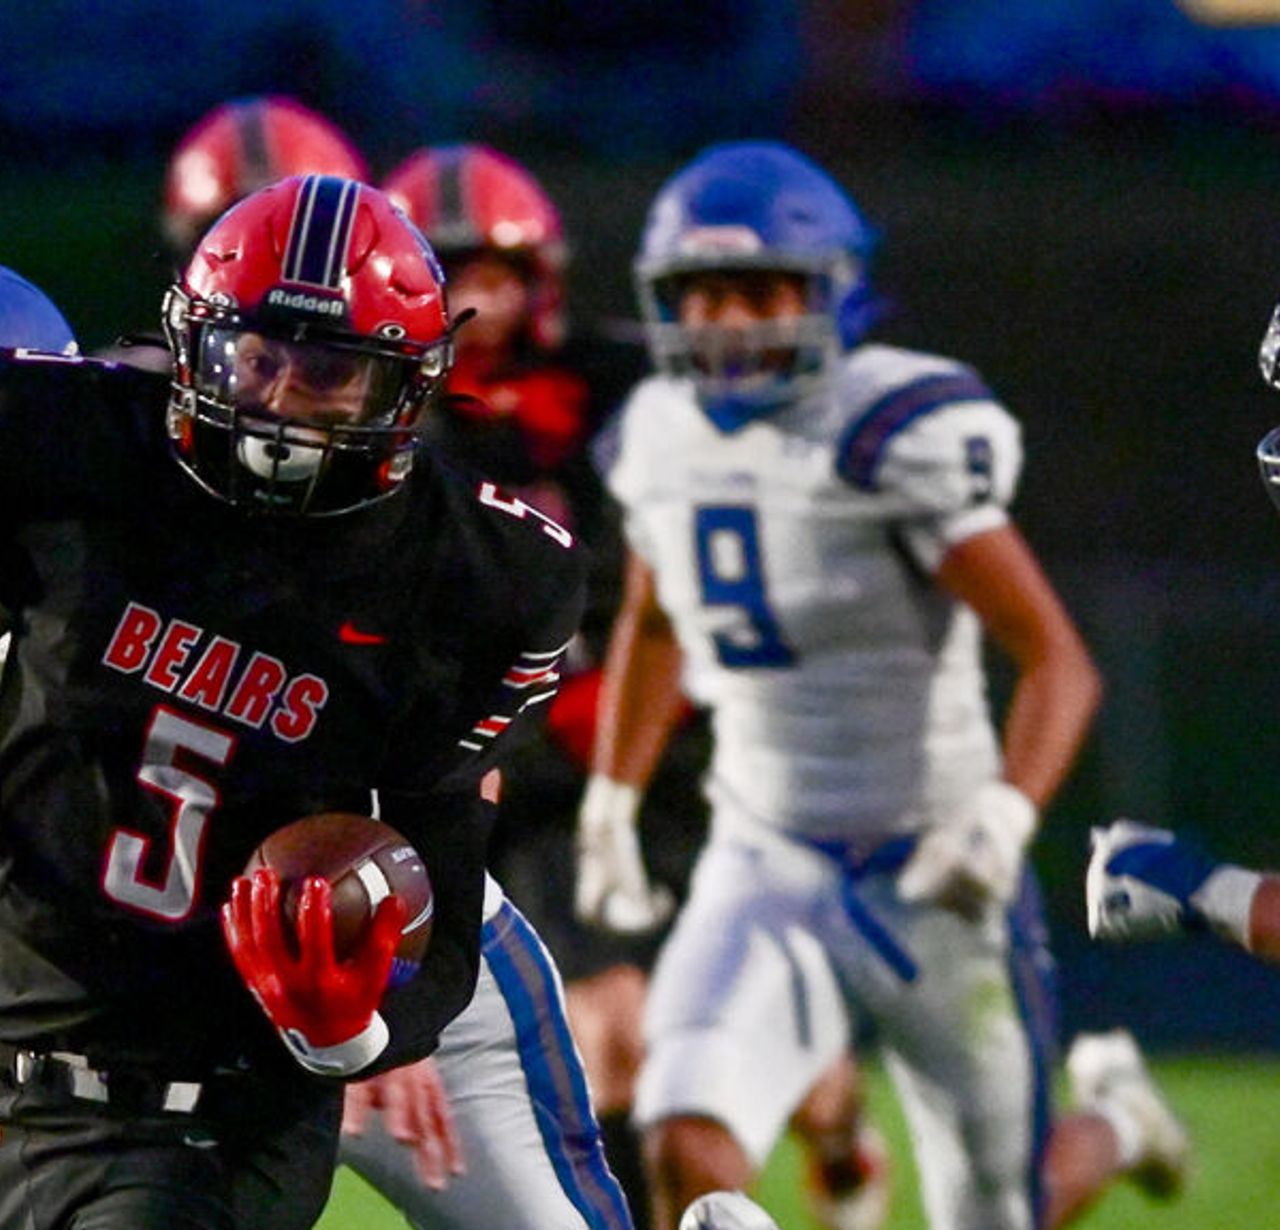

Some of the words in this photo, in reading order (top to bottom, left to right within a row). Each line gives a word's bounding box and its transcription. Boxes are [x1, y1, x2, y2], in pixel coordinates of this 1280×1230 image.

[480, 482, 572, 548] 5
[696, 504, 798, 668] 9
[103, 601, 329, 743] BEARS
[102, 703, 237, 922] 5
